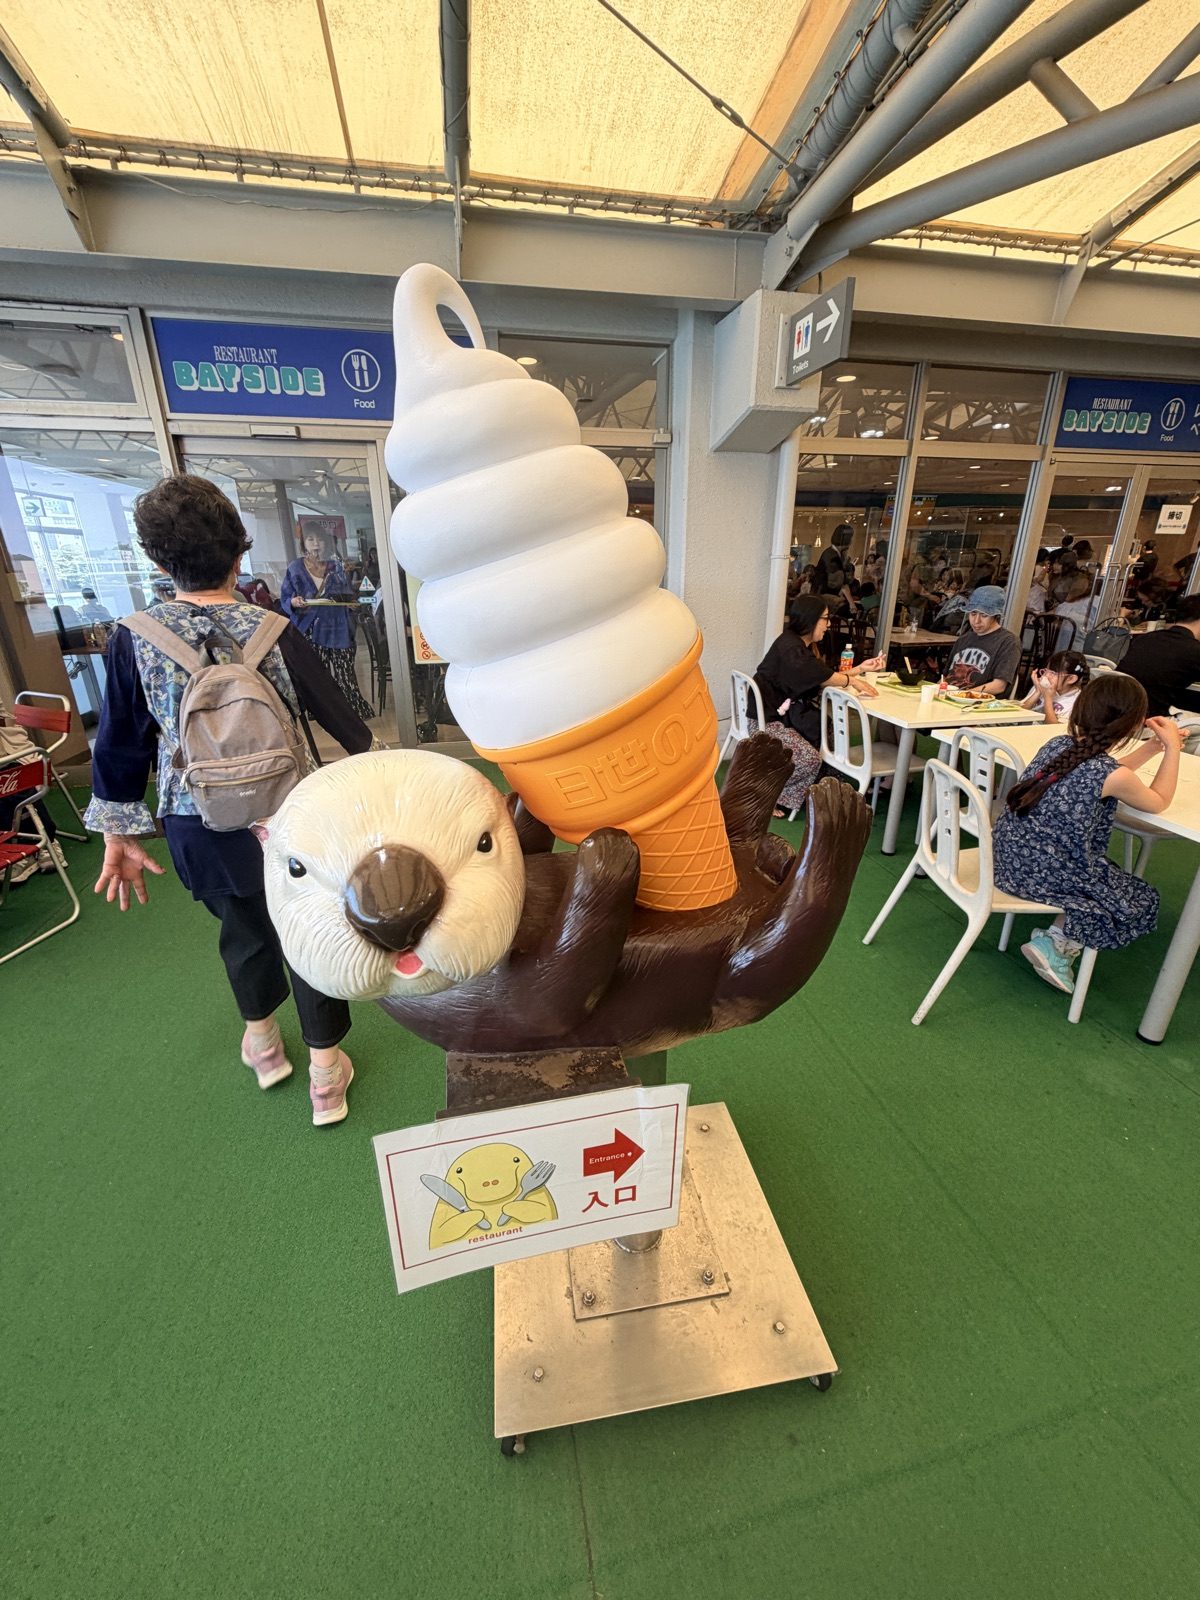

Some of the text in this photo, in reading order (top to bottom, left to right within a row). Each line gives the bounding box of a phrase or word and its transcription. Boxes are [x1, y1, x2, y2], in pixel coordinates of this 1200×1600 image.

[213, 345, 278, 365] RESTAURANT
[792, 360, 809, 374] Toilets
[172, 361, 326, 397] BAYSIDE
[353, 398, 376, 409] Food
[1092, 397, 1133, 411] RESTAURANT
[1062, 409, 1152, 434] BAYSIDE
[1160, 433, 1175, 442] Food
[589, 1151, 626, 1165] Entrance
[581, 1184, 637, 1213] 入口
[468, 1226, 523, 1244] restaurant
